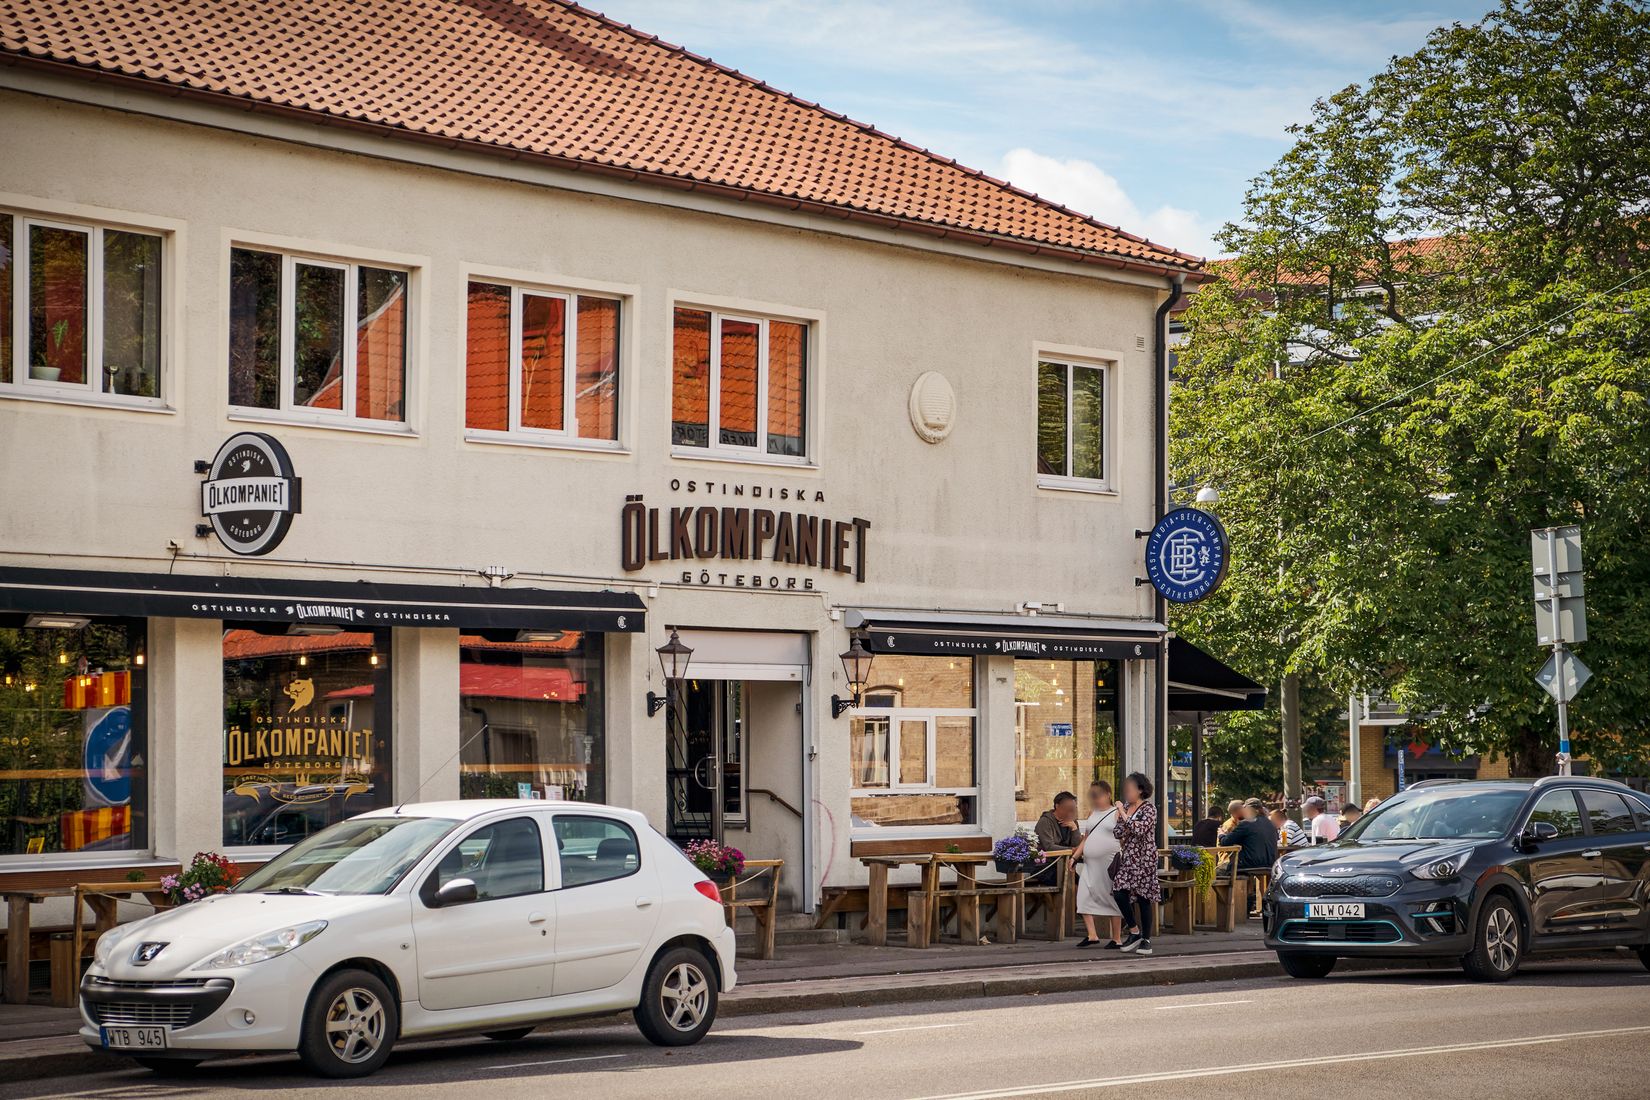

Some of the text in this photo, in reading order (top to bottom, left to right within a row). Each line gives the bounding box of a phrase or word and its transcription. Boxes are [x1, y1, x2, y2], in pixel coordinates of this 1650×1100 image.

[229, 450, 265, 467] OSTINDISKA
[209, 482, 284, 508] ÖLKOMPANIET
[670, 479, 825, 502] OSTINDISKA
[622, 494, 871, 583] ÖLKOMPANIET
[1150, 513, 1221, 578] EAST INDIA BEER COMPANY
[682, 569, 813, 590] GÖTEBORG
[192, 603, 450, 622] OSTINDISKA ÖLKOMPANIET OSTINDISKA
[934, 640, 1104, 654] OSTINDISKA ÖLKOMPANIET OSTINDISKA
[256, 716, 348, 724] OSTINDISKA
[228, 725, 374, 766] ÖLKOMPANIET
[263, 761, 342, 769] GÖTEBORG
[1313, 904, 1360, 916] NLW 042
[108, 1029, 162, 1046] WTB 945
